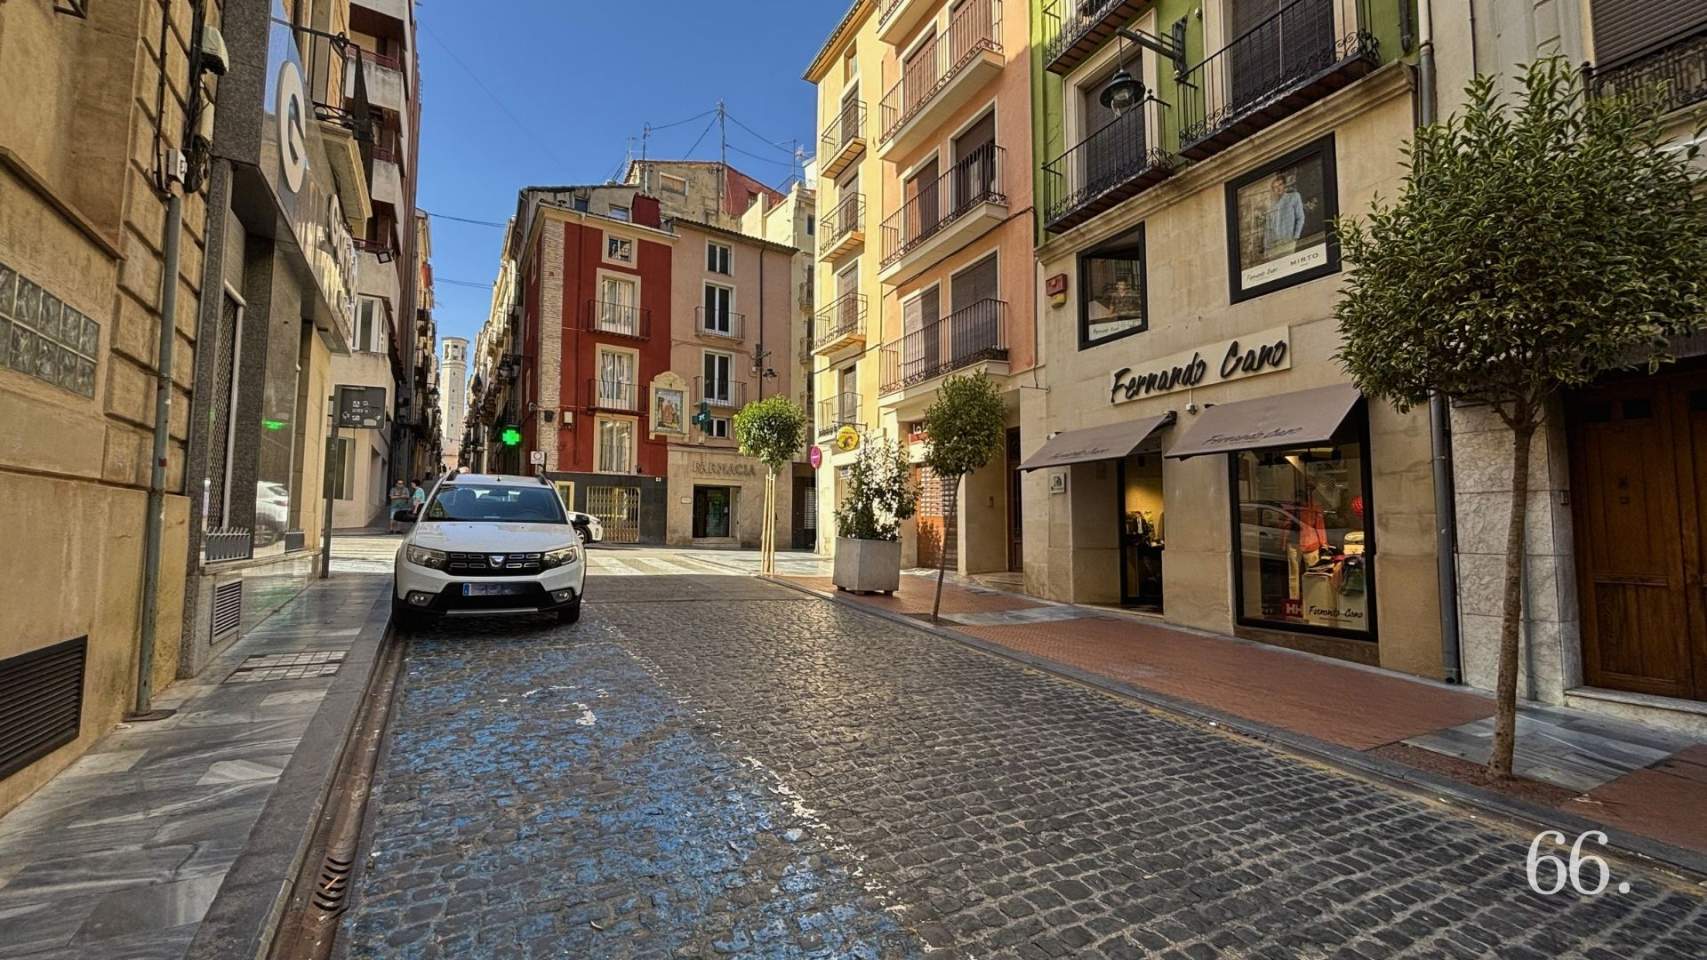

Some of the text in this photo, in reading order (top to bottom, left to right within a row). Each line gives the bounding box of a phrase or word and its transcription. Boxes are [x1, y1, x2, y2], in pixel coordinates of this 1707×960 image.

[1290, 252, 1319, 266] MIRTO
[1110, 340, 1287, 403] Fernando Cano
[693, 462, 756, 476] FARMACIA
